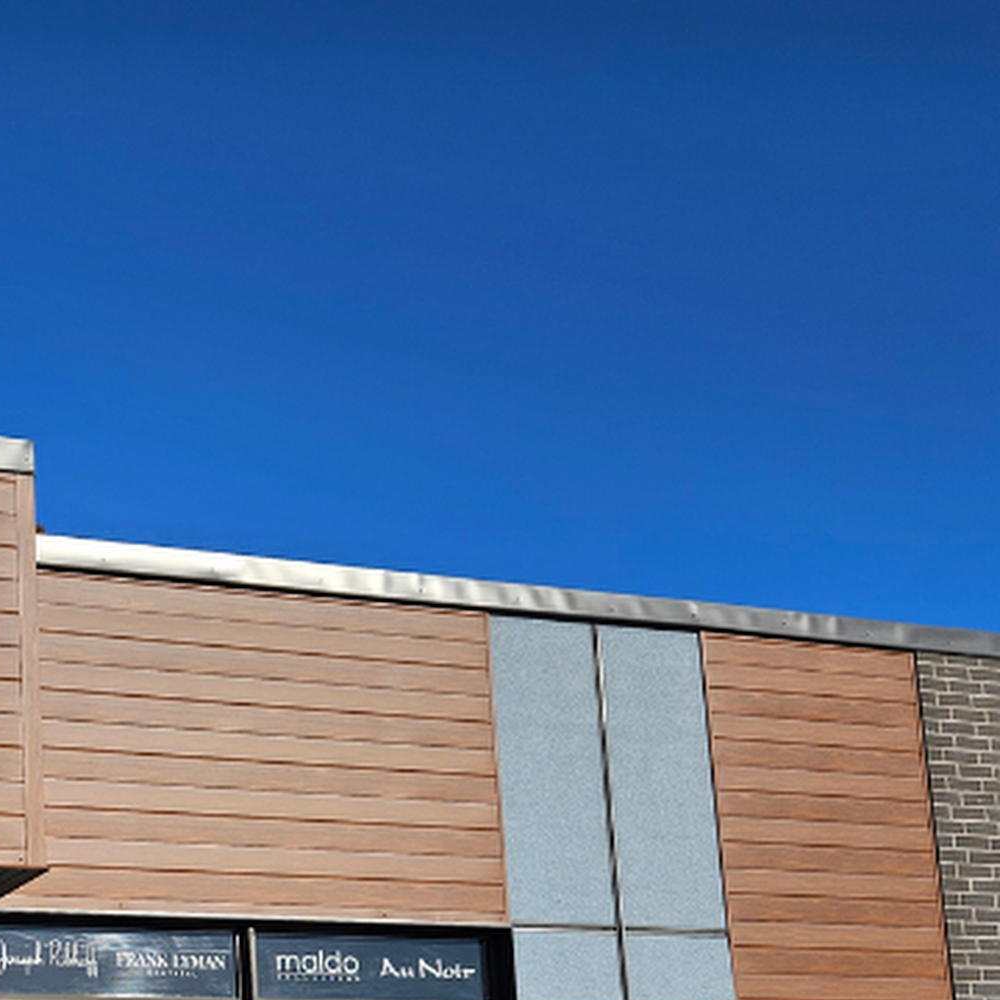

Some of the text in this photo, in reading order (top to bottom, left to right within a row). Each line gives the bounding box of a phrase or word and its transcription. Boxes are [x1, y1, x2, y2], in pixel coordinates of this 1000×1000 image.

[276, 949, 360, 974] maldo
[380, 957, 415, 978] Au
[418, 957, 476, 979] Noir
